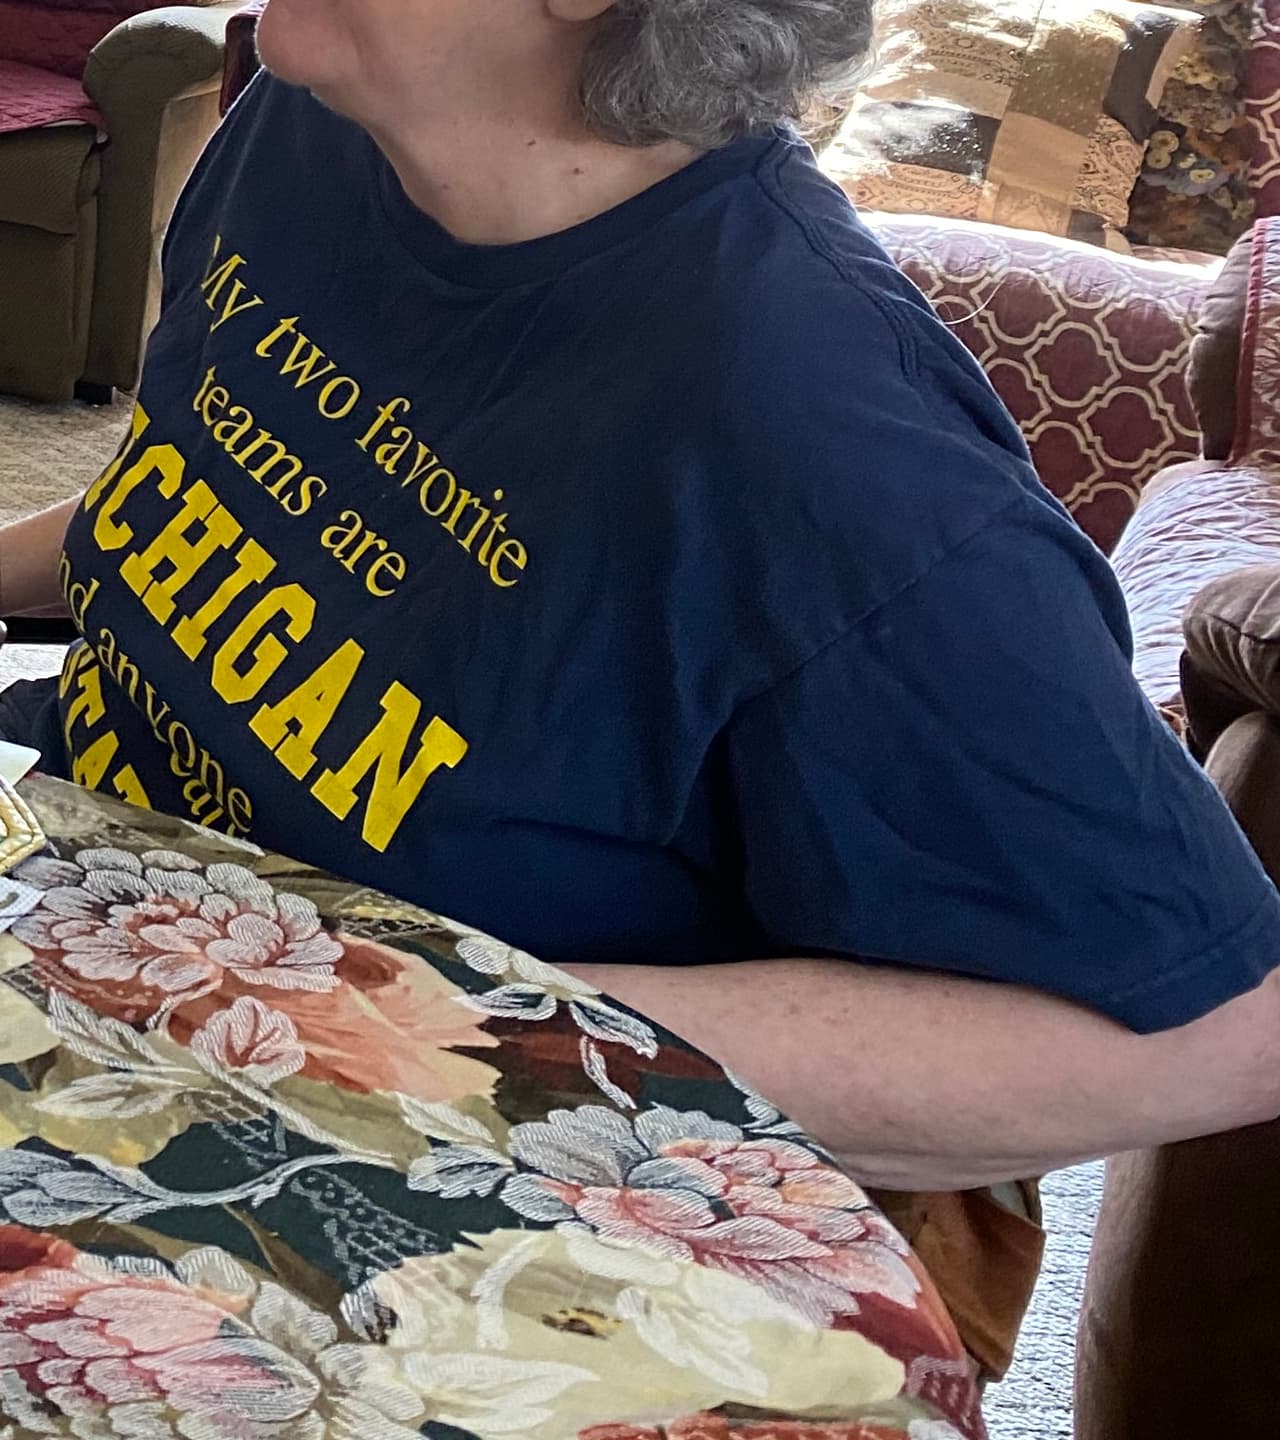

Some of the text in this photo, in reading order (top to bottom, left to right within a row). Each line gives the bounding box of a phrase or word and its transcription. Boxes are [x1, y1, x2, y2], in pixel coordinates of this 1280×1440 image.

[191, 366, 407, 598] teams are
[255, 315, 361, 420] two
[354, 396, 528, 589] favorite
[85, 401, 469, 853] ICHIGAN
[97, 627, 253, 833] anyone
